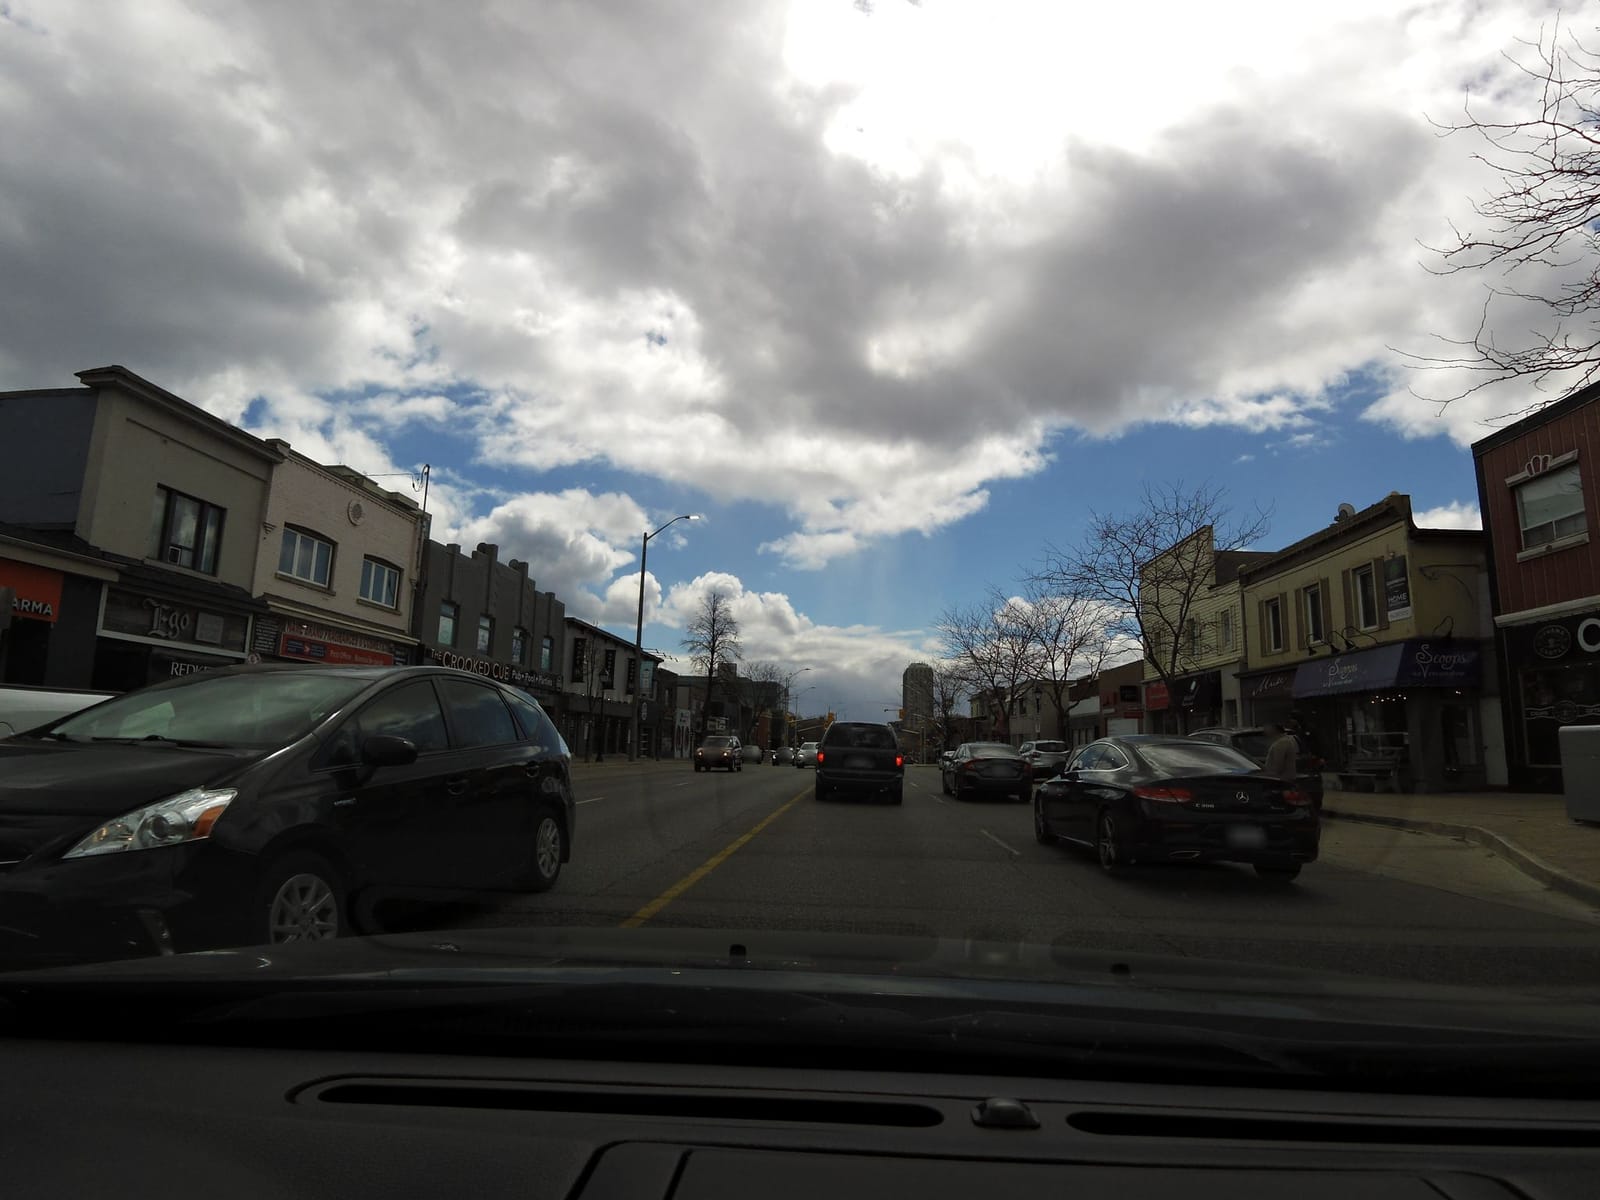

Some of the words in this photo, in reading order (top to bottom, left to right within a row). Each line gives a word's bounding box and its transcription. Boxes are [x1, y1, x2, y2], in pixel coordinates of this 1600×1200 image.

[142, 598, 190, 639] Ego
[442, 651, 490, 676] CROOKED
[492, 662, 510, 681] CUE
